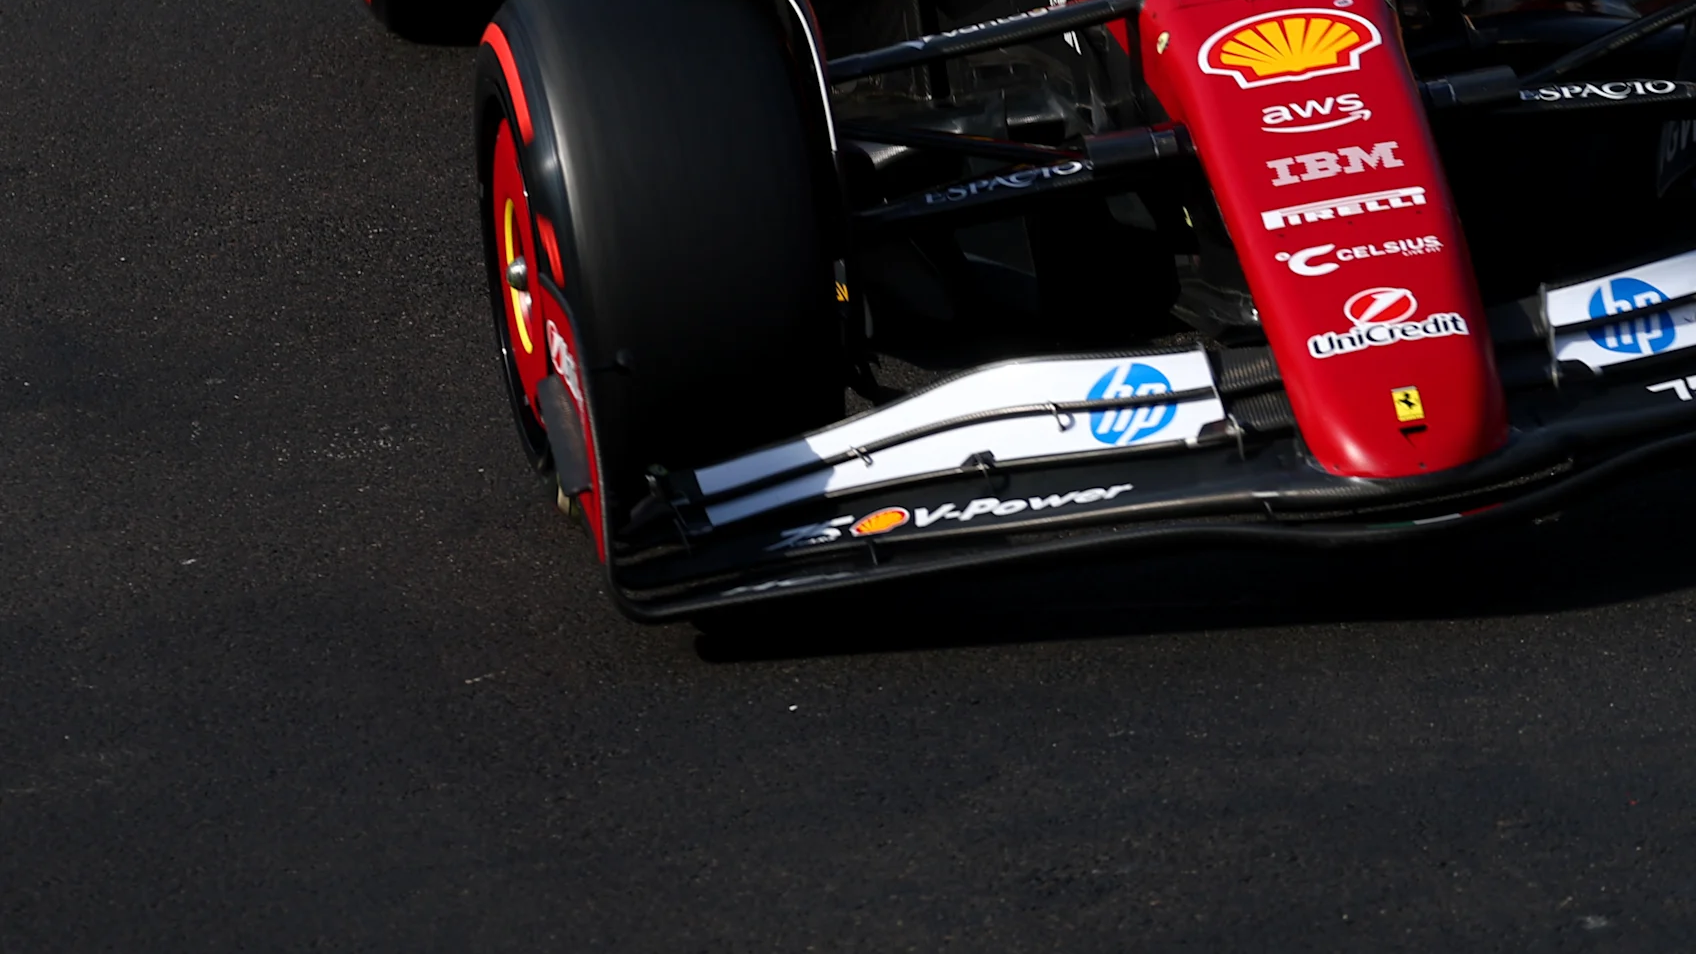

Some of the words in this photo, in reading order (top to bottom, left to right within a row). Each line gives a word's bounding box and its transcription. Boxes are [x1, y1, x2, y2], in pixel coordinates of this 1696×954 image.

[1262, 92, 1366, 126] aws
[1266, 141, 1404, 187] IBM
[1260, 186, 1427, 231] PIRELLI
[1336, 235, 1444, 261] CELSIUS
[1311, 313, 1467, 357] UniCredit
[914, 482, 1133, 528] V-Power
